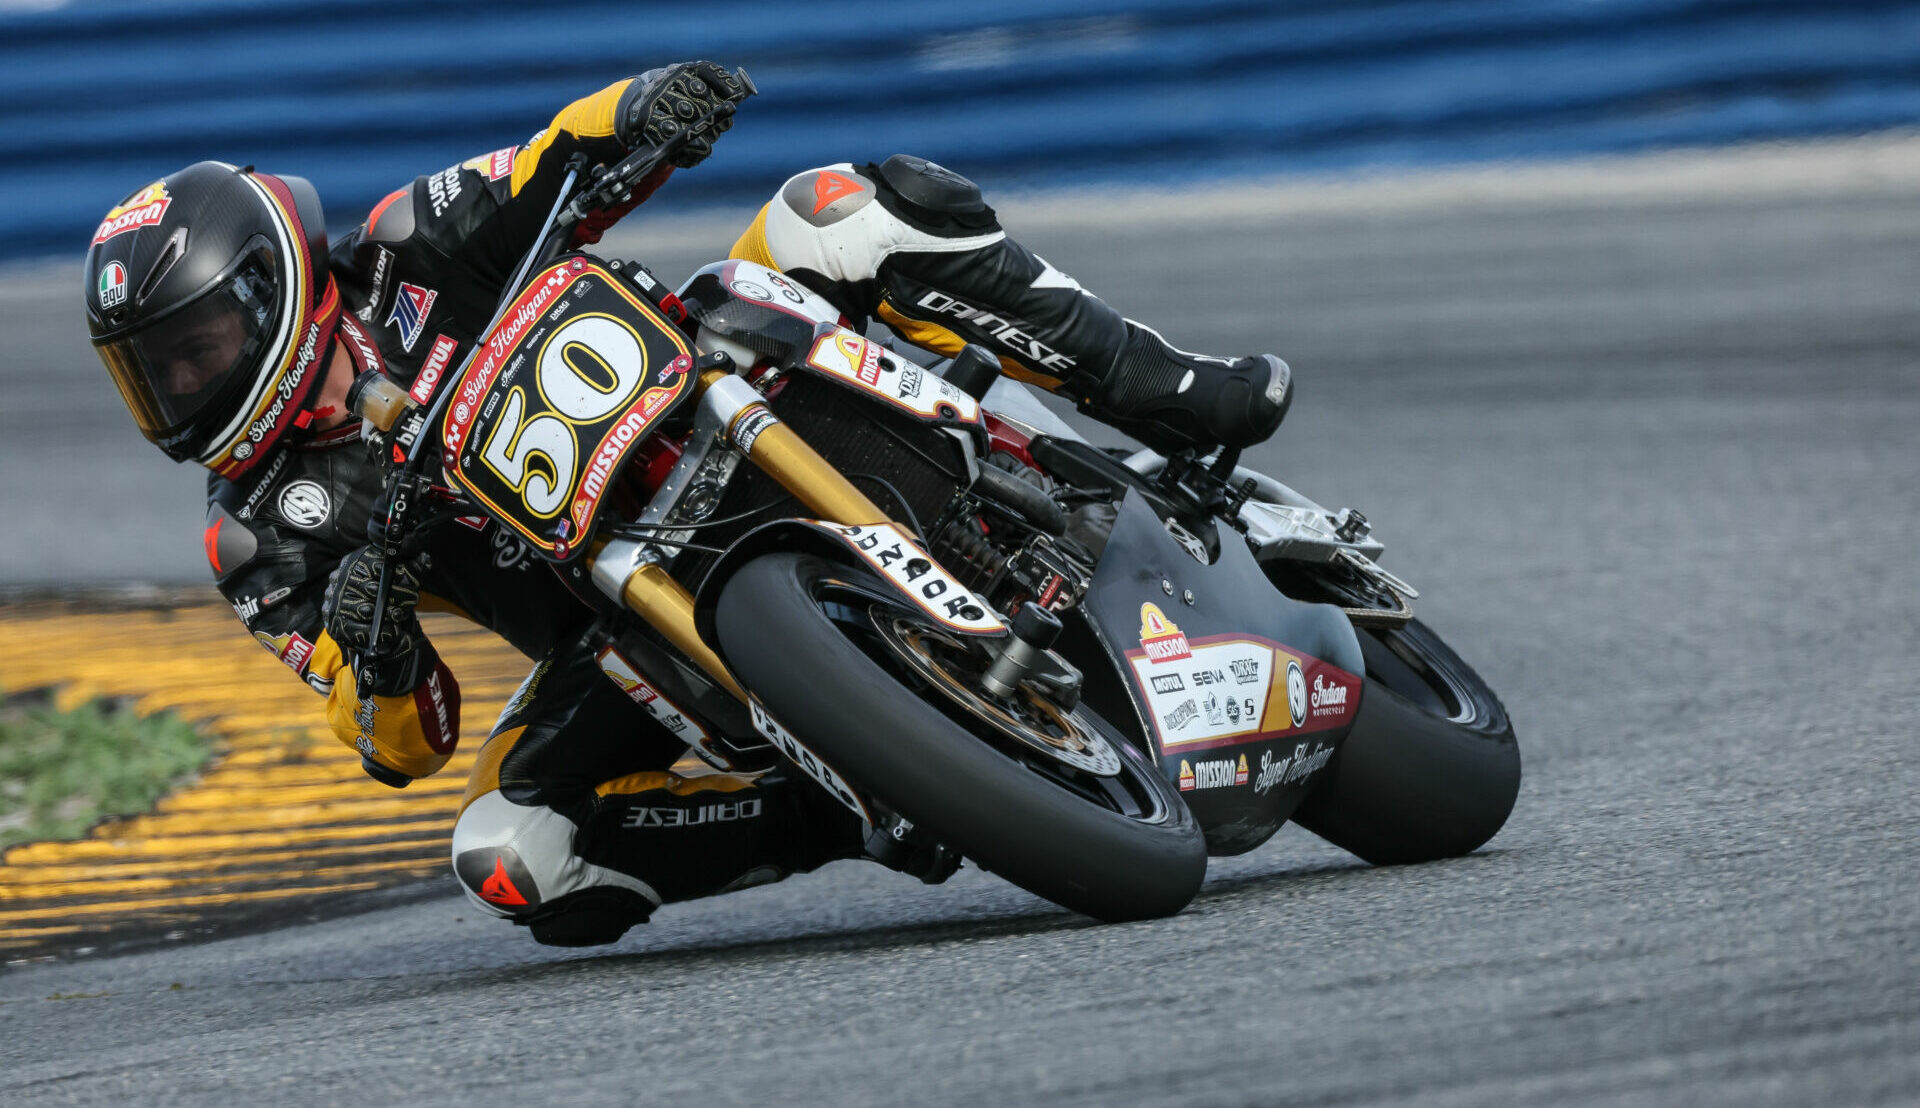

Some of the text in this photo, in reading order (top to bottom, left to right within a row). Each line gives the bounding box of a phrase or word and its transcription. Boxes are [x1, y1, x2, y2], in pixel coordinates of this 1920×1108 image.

[463, 352, 496, 406] Super
[491, 285, 553, 358] Hooligan
[916, 290, 1077, 372] DAINESE
[248, 321, 320, 442] Super Hooligan
[414, 339, 454, 401] MOTUL
[480, 312, 648, 519] 50
[584, 412, 646, 499] MISSION
[1145, 637, 1189, 660] MISSION
[1155, 675, 1184, 693] MOTUL
[1192, 669, 1227, 686] SENA
[1311, 674, 1347, 708] Indian
[1196, 760, 1236, 789] MISSION
[1254, 750, 1292, 796] Super
[621, 799, 762, 828] DAINESE
